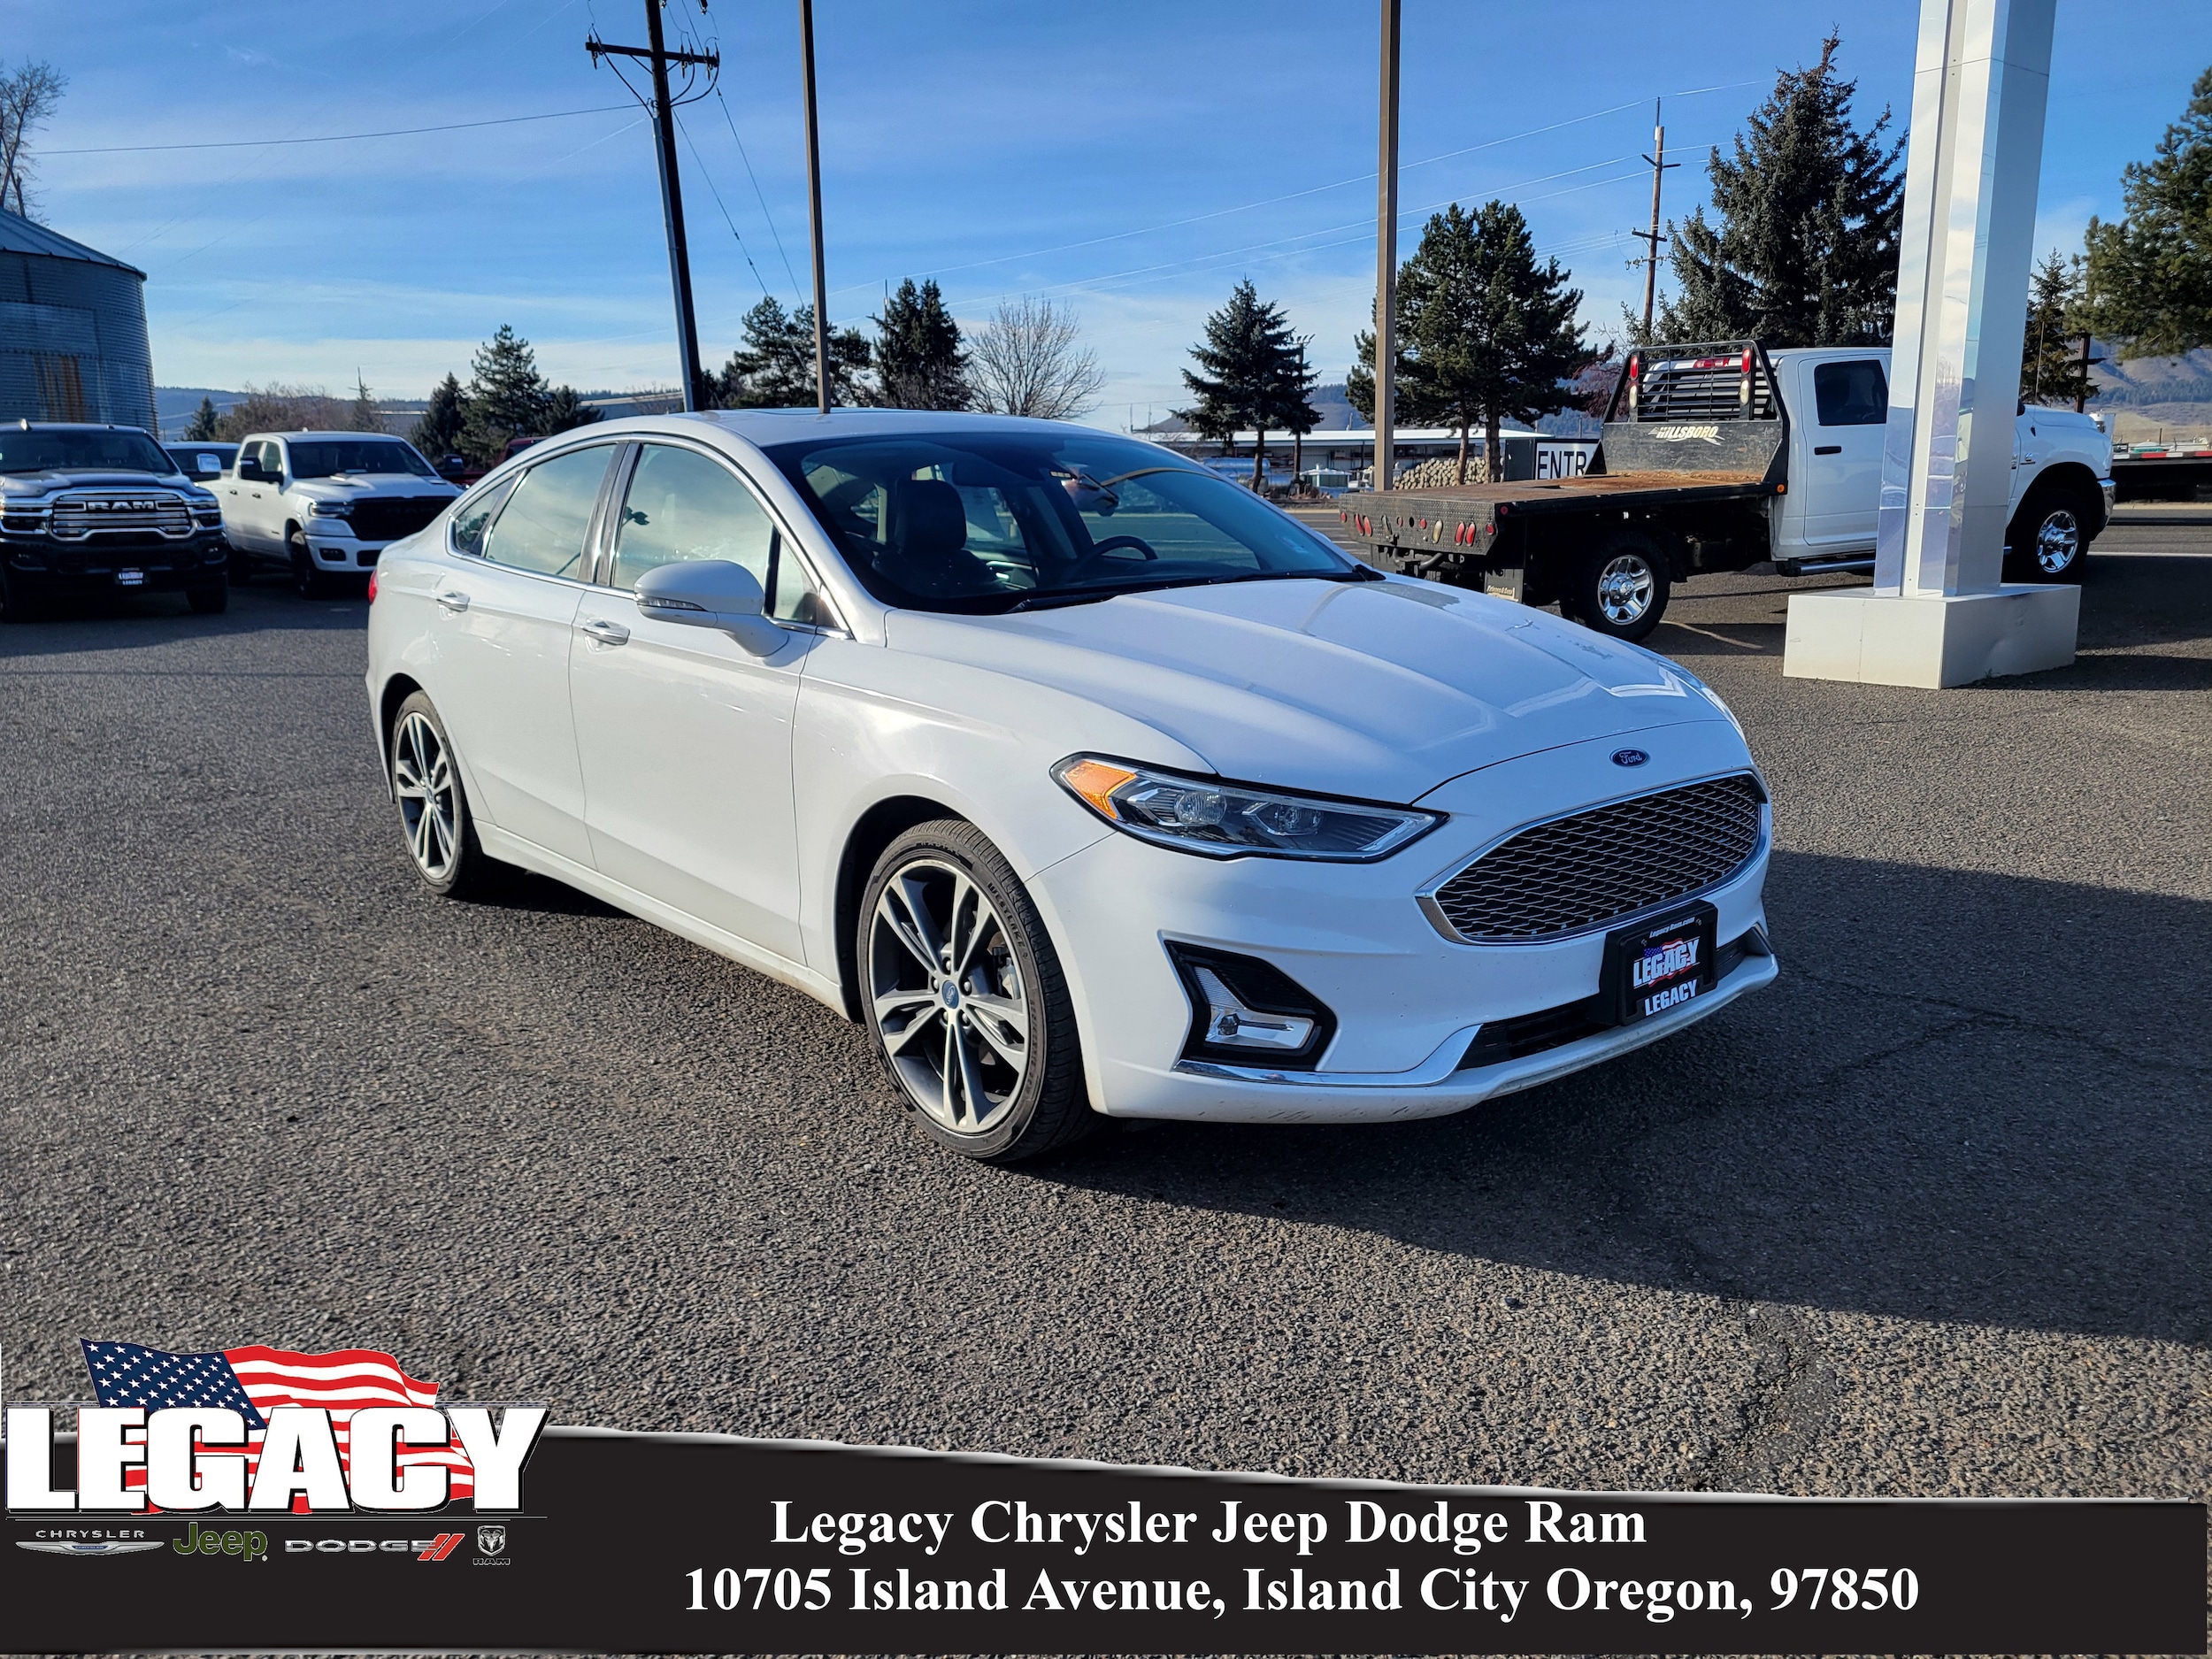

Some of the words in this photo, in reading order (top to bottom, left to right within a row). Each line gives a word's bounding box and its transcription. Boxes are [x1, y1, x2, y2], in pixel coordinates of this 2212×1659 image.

[1656, 426, 1718, 439] HILLSBORO
[88, 501, 155, 511] RAM
[1618, 750, 1643, 764] Ford
[1632, 938, 1700, 987] LEGACY
[1645, 979, 1698, 1017] LEGACY
